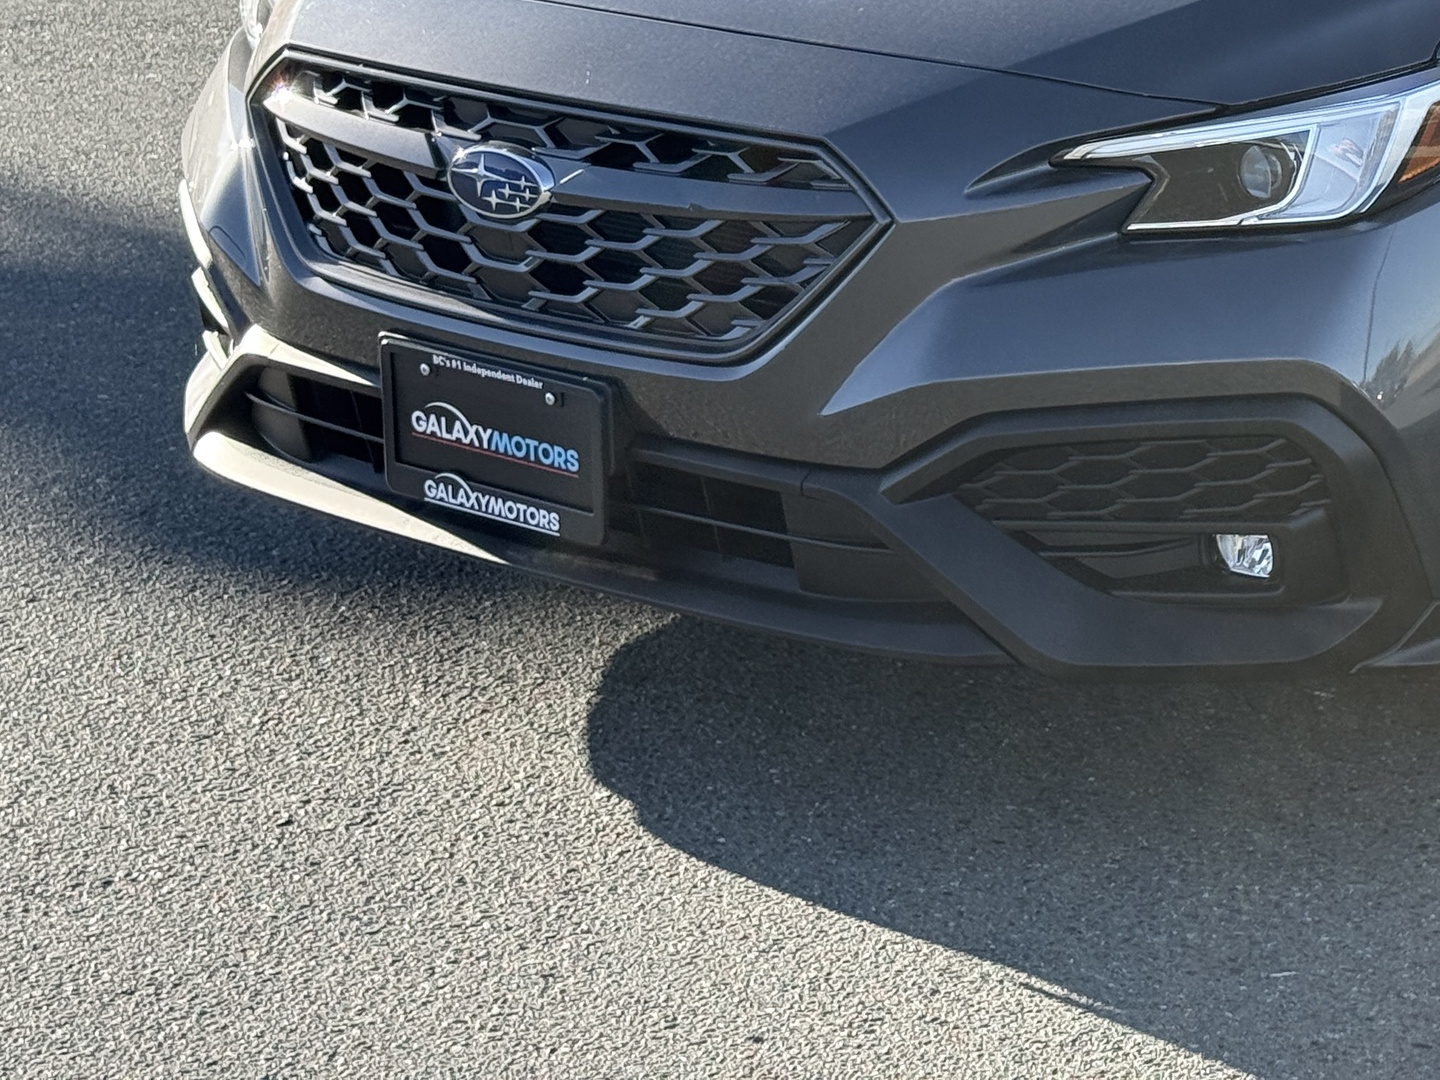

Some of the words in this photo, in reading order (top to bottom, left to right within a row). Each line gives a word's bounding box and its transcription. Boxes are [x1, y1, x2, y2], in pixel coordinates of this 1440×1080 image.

[463, 362, 516, 383] Independent
[516, 374, 544, 389] Dealer
[411, 410, 579, 472] GALAXYMOTORS
[424, 479, 560, 531] GALAXYMOTORS
